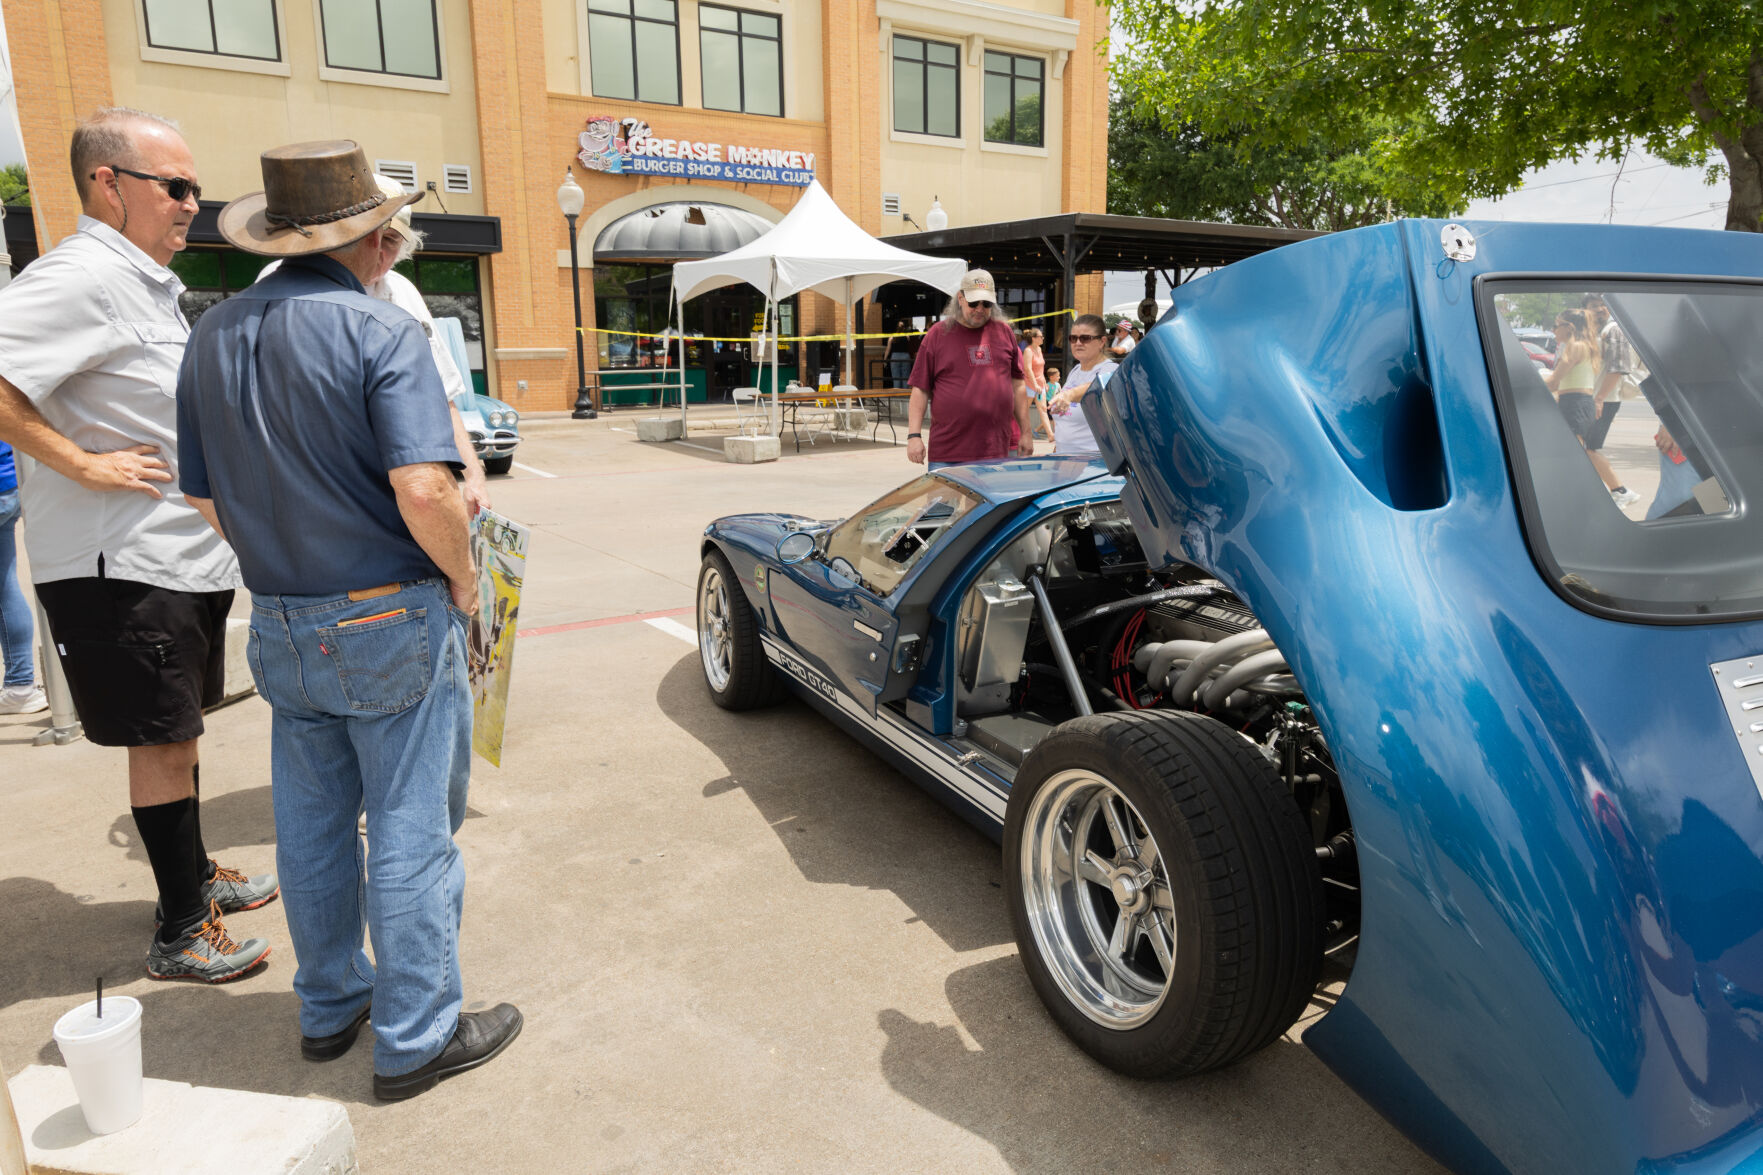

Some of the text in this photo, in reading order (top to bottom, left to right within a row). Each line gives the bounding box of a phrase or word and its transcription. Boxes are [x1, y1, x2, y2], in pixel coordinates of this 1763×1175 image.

[622, 118, 652, 137] The
[629, 138, 815, 170] GREASE MONKEY
[633, 159, 684, 174] BURGER
[687, 163, 721, 177] SHOP
[724, 166, 734, 178] &
[736, 167, 779, 181] SOCIAL
[779, 653, 837, 700] FORD GT40
